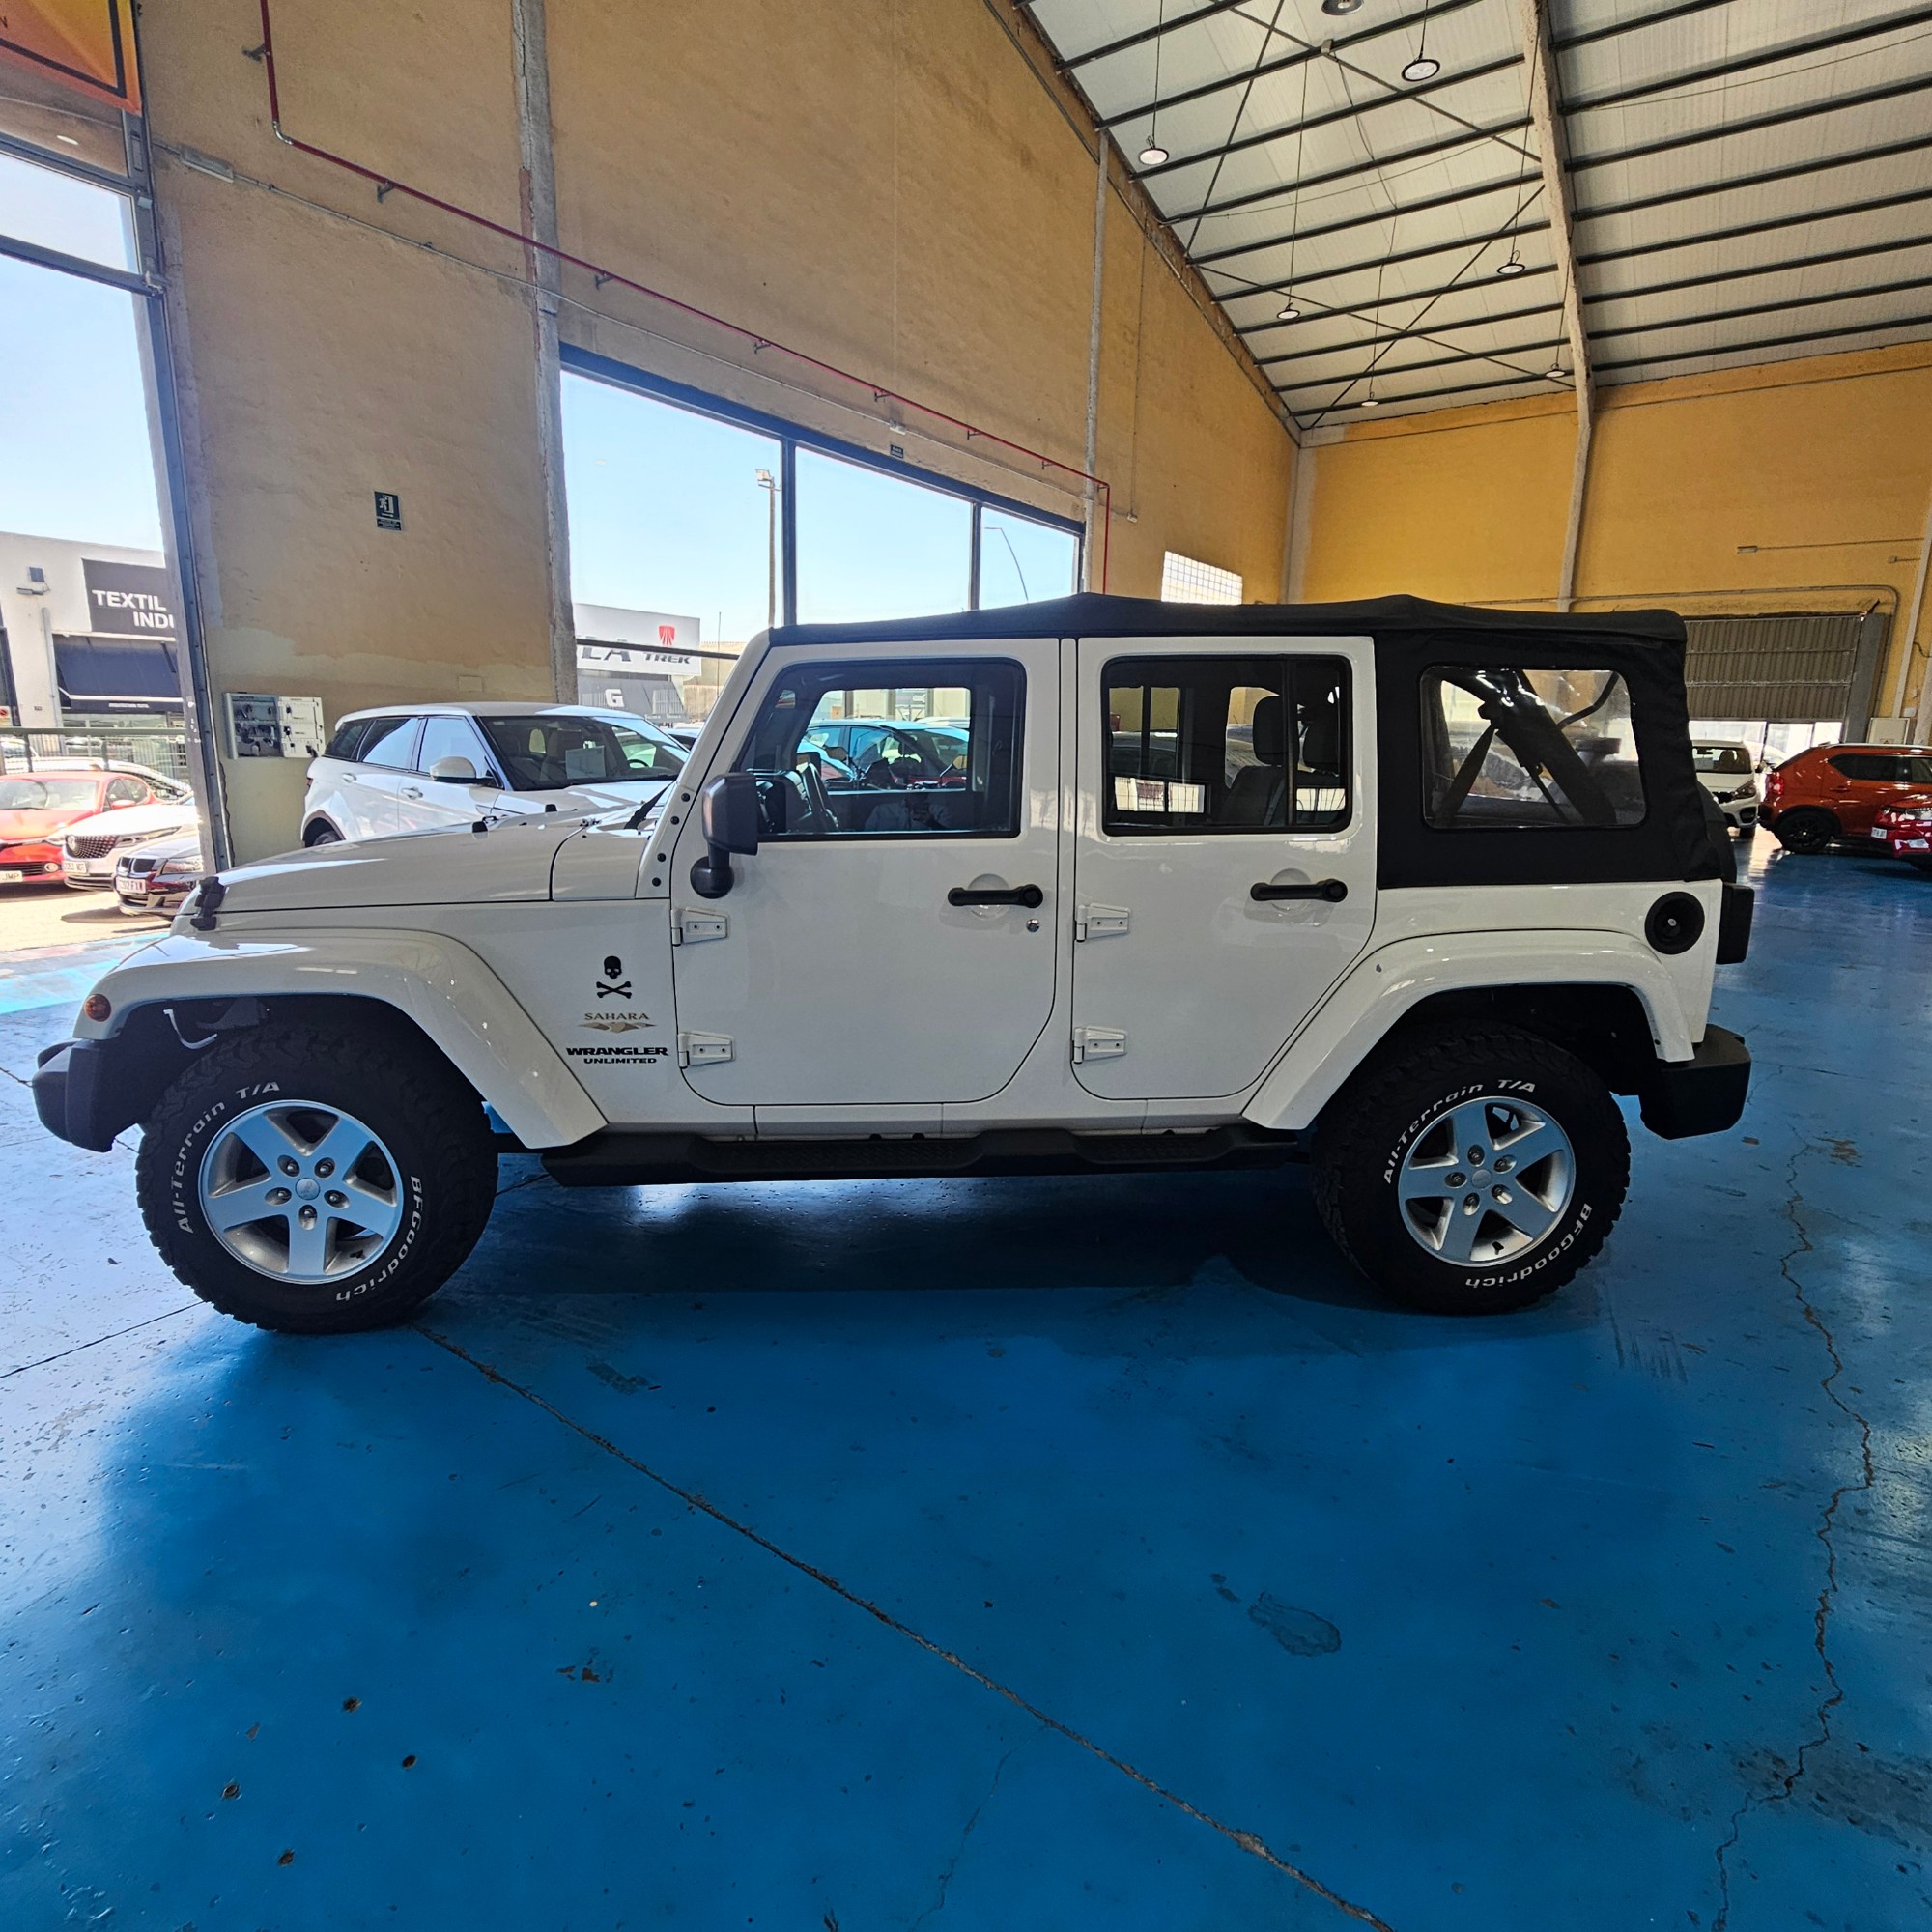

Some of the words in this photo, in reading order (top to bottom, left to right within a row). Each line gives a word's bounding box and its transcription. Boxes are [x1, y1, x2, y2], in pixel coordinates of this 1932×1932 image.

[92, 589, 166, 611] TEXTIL
[644, 652, 690, 664] TREK
[584, 1012, 650, 1021] SAHARA
[566, 1047, 669, 1056] WRANGLER
[172, 1102, 226, 1234] All-Terrain
[236, 1081, 280, 1100] T/A
[1383, 1083, 1483, 1184] All-Terrain
[1497, 1079, 1536, 1093] T/A
[335, 1175, 423, 1302] BFGoodrich
[1465, 1202, 1593, 1288] BFGoodrich
